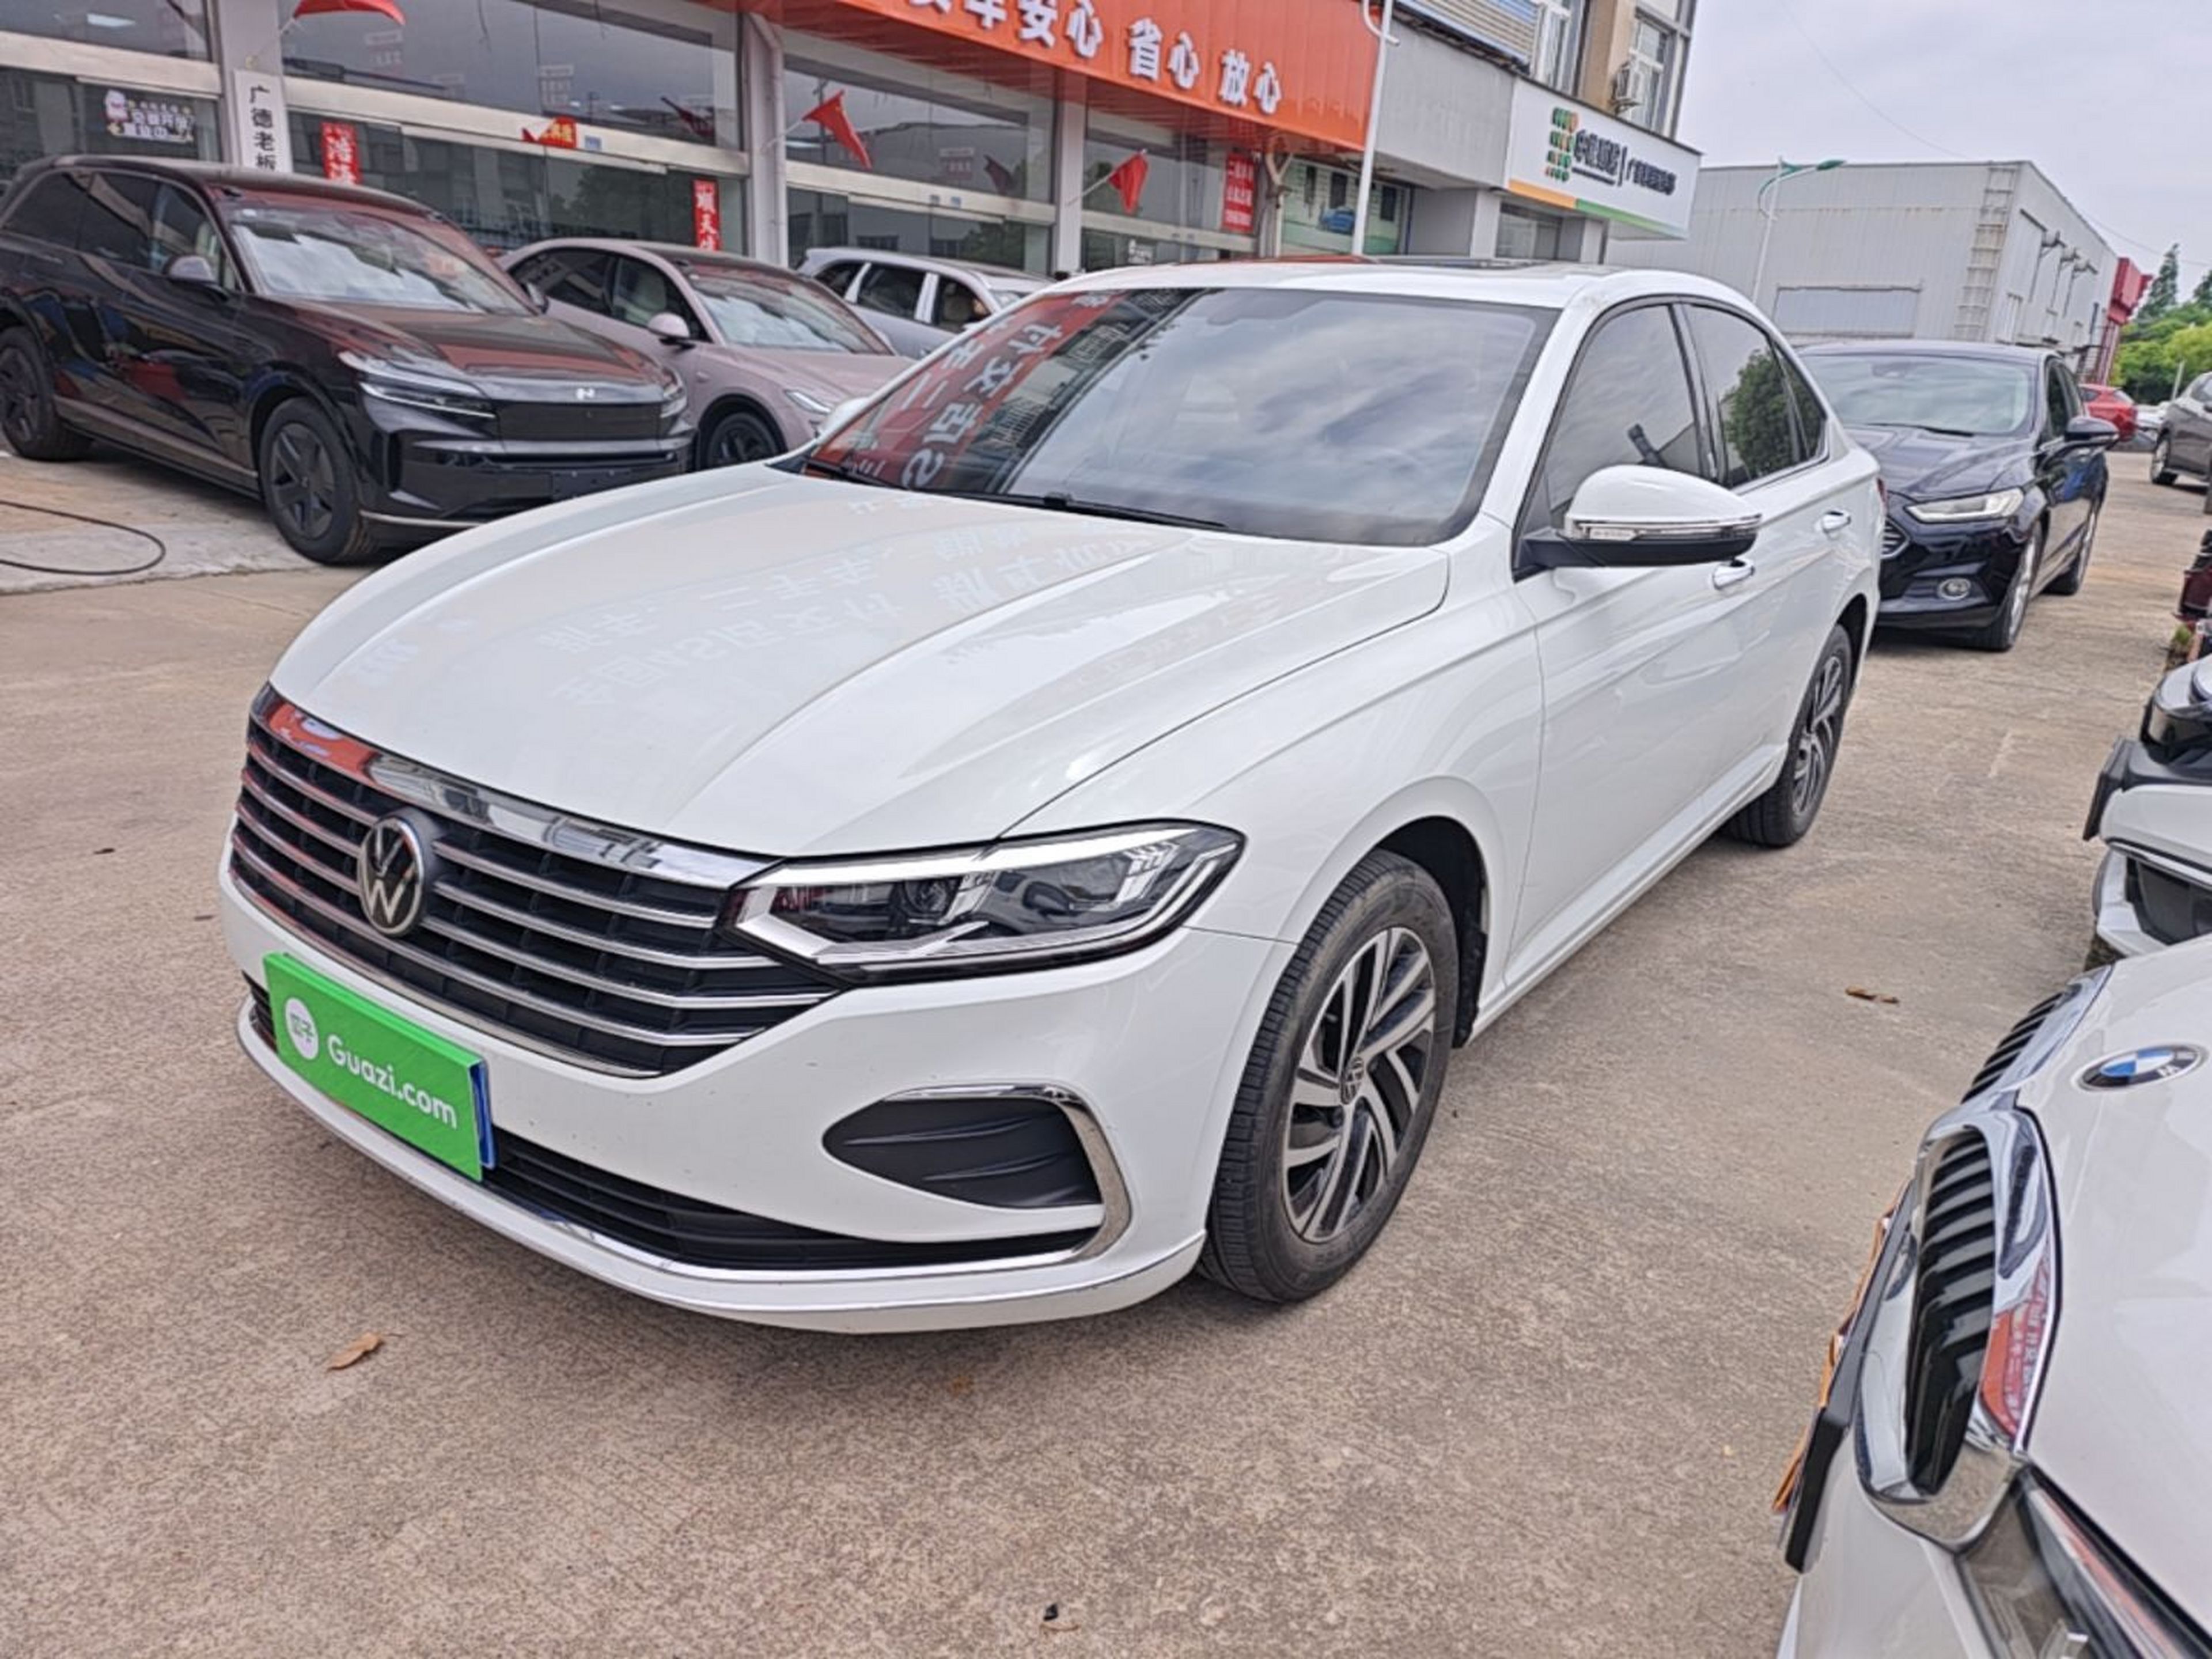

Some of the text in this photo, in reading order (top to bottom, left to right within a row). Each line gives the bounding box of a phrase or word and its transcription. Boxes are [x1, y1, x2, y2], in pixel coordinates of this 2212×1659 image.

[908, 0, 1282, 115] 安心 省心 放心
[327, 1034, 457, 1130] Guazi.com
